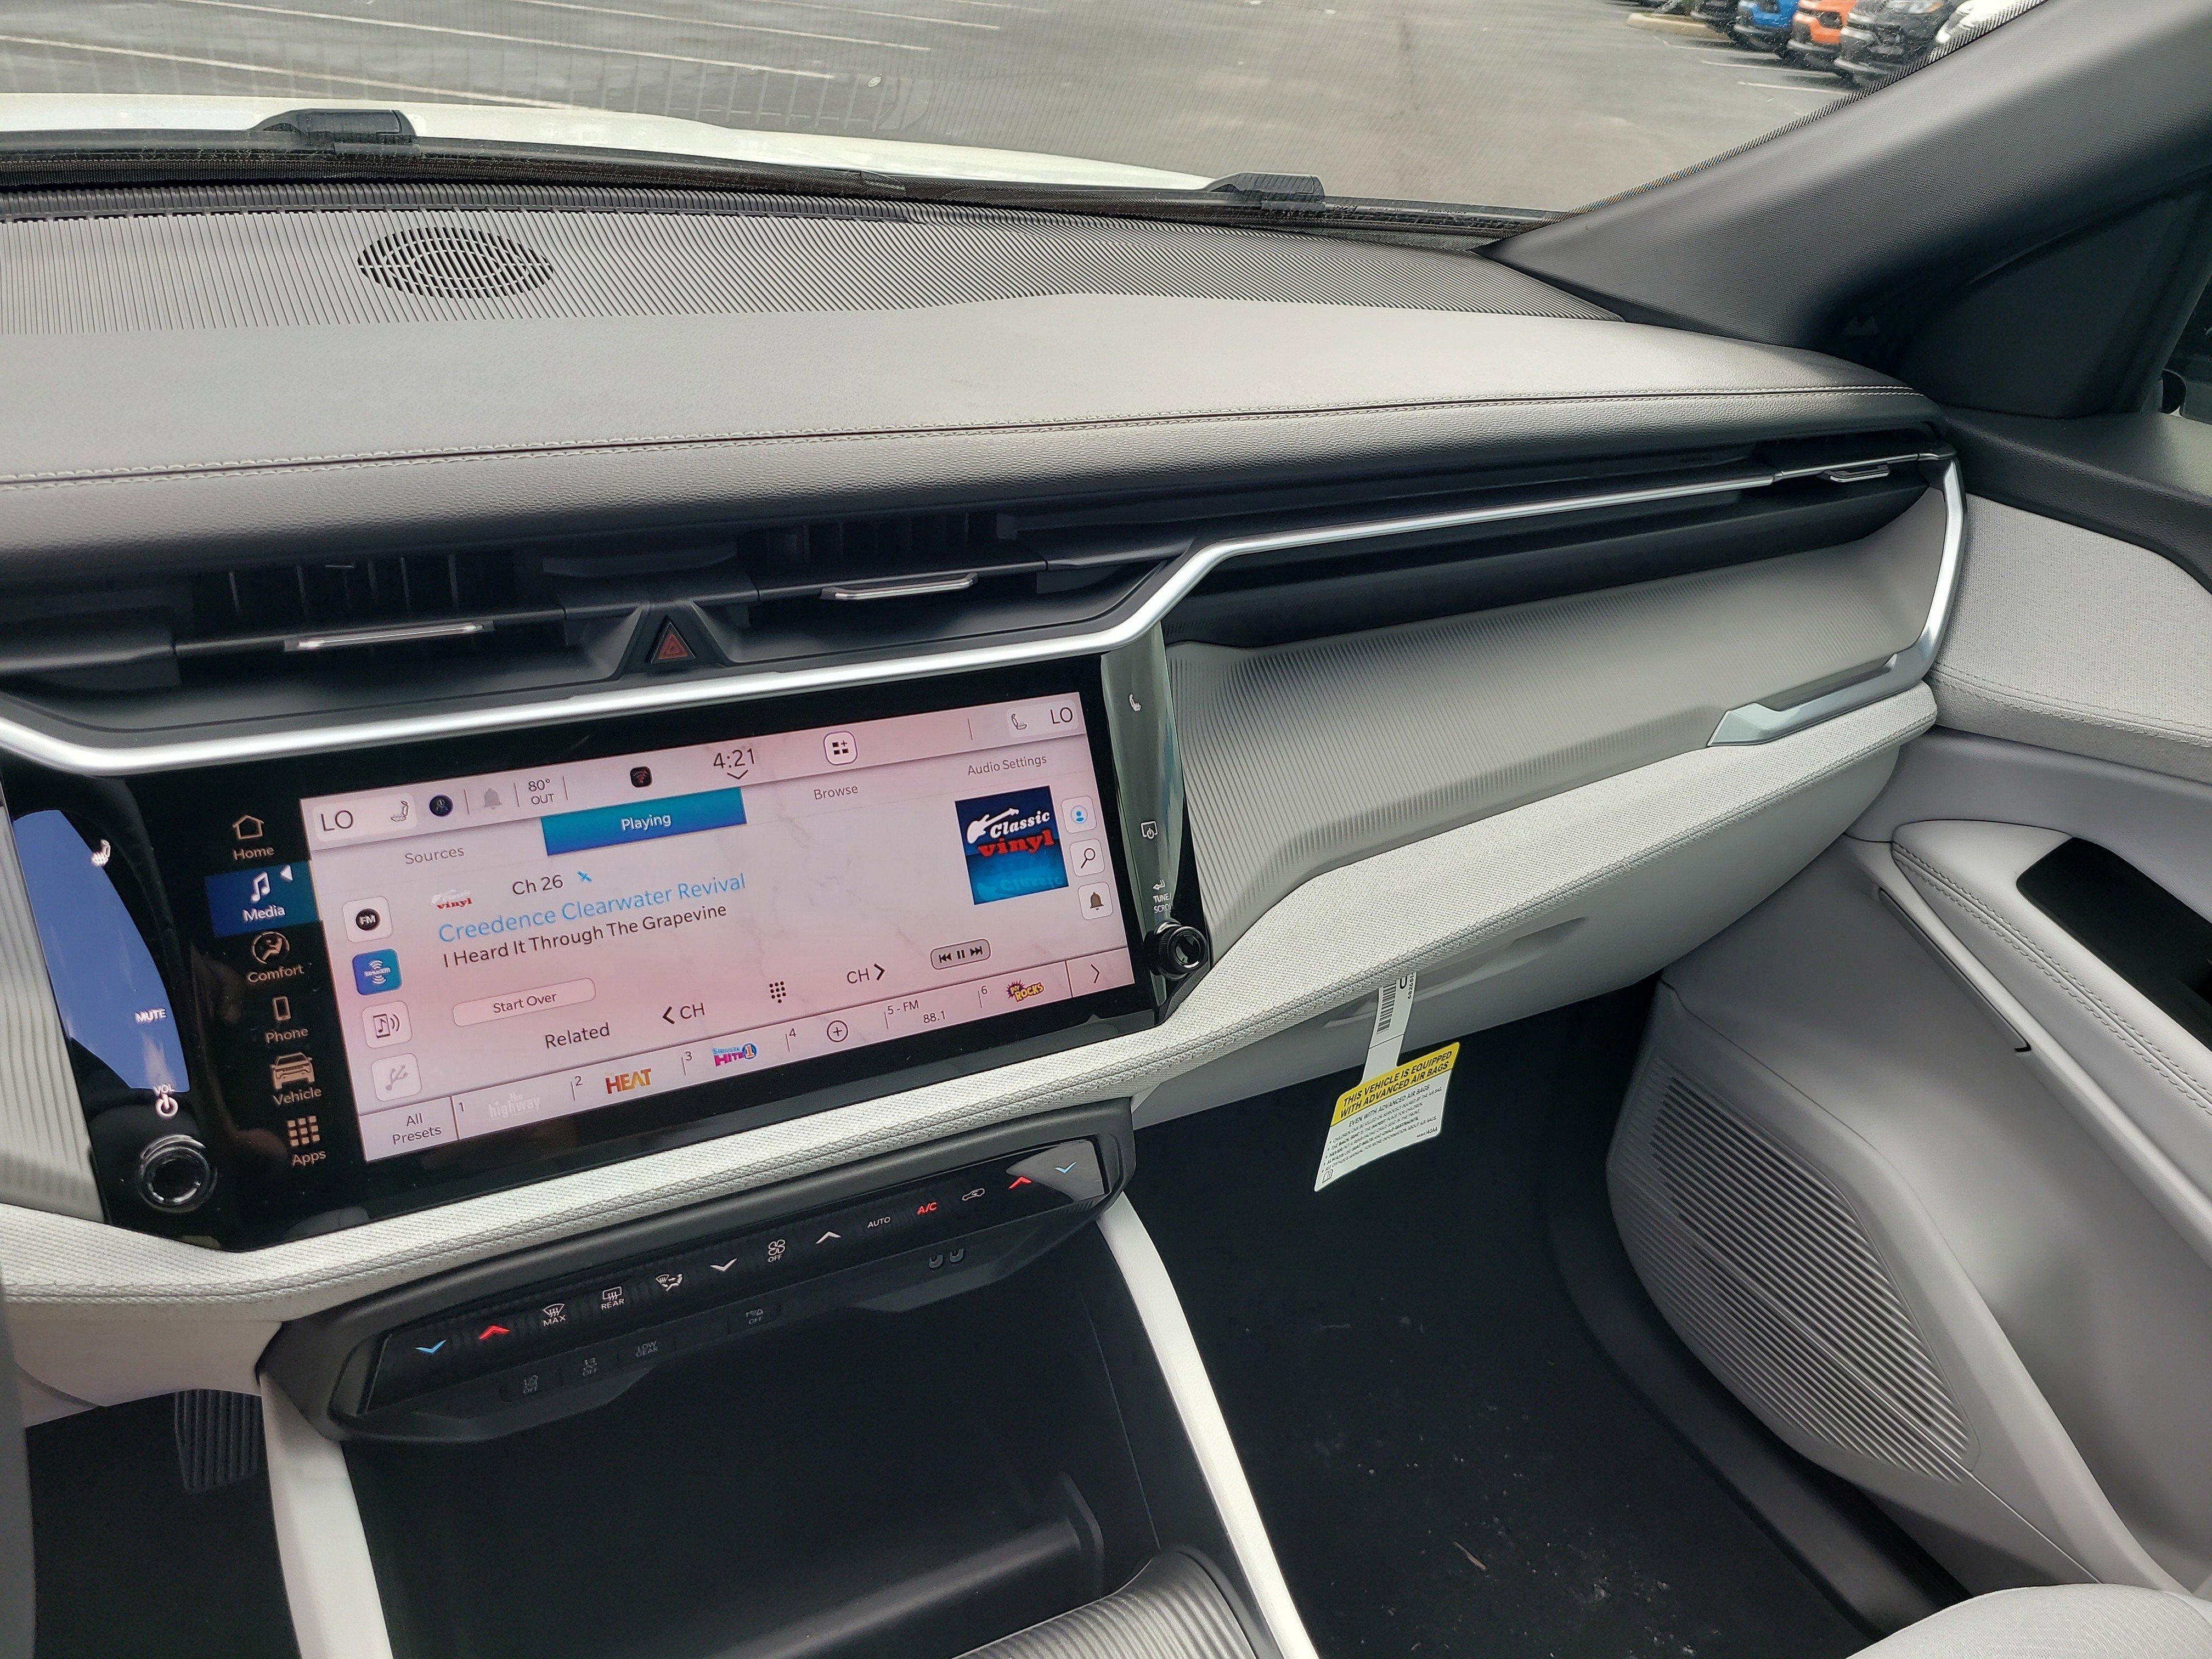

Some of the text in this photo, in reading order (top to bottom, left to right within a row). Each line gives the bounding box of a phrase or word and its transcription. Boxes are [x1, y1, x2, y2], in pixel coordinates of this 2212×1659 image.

[1050, 707, 1074, 725] LO
[713, 748, 755, 769] 4:21
[967, 754, 1047, 776] Audio Settings
[528, 778, 551, 792] 80°
[814, 785, 859, 800] Browse
[531, 793, 555, 805] OUT
[320, 810, 354, 832] LO
[620, 814, 672, 832] Playing
[989, 810, 1051, 838] Classic
[978, 829, 1055, 857] vinyl
[233, 847, 274, 861] Home
[404, 847, 465, 865] Sources
[512, 874, 564, 895] Ch 26
[437, 898, 473, 909] vinyl
[438, 872, 746, 942] Creedence Clearwater Revival
[242, 905, 286, 922] Media
[359, 915, 376, 925] FM
[443, 905, 727, 967] I Heard It Through The Grapevine
[247, 964, 304, 983] Comfort
[847, 968, 870, 984] CH
[981, 985, 988, 995] 6
[1015, 984, 1043, 1001] ROCKS
[493, 993, 558, 1013] Start Over
[680, 1003, 706, 1019] CH
[887, 1005, 894, 1015] 5
[903, 1000, 919, 1012] FM
[134, 1008, 167, 1024] MUTE
[923, 1010, 946, 1024] 88.1
[265, 1027, 309, 1043] Phone
[545, 1022, 611, 1049] Related
[789, 1028, 797, 1037] 4
[685, 1051, 692, 1061] 3
[574, 1076, 583, 1086] 2
[605, 1068, 652, 1094] HEAT
[1344, 1051, 1452, 1107] THIS VEHICLE IS EQUIPPED
[153, 1083, 175, 1096] VOL
[273, 1087, 322, 1106] Vehicle
[1340, 1102, 1362, 1118] WITH
[1363, 1080, 1410, 1109] ADVANCED
[1410, 1073, 1425, 1084] AIR
[1426, 1061, 1449, 1077] BAGS
[459, 1102, 465, 1112] 1
[488, 1097, 540, 1118] highway
[406, 1113, 424, 1127] All
[1348, 1115, 1362, 1127] EVEN
[393, 1126, 442, 1145] Presets
[291, 1151, 327, 1167] Apps
[917, 1202, 938, 1216] A/C
[867, 1216, 891, 1228] AUTO
[768, 1254, 782, 1263] OFF
[601, 1298, 625, 1310] REAR
[543, 1314, 567, 1327] MAX
